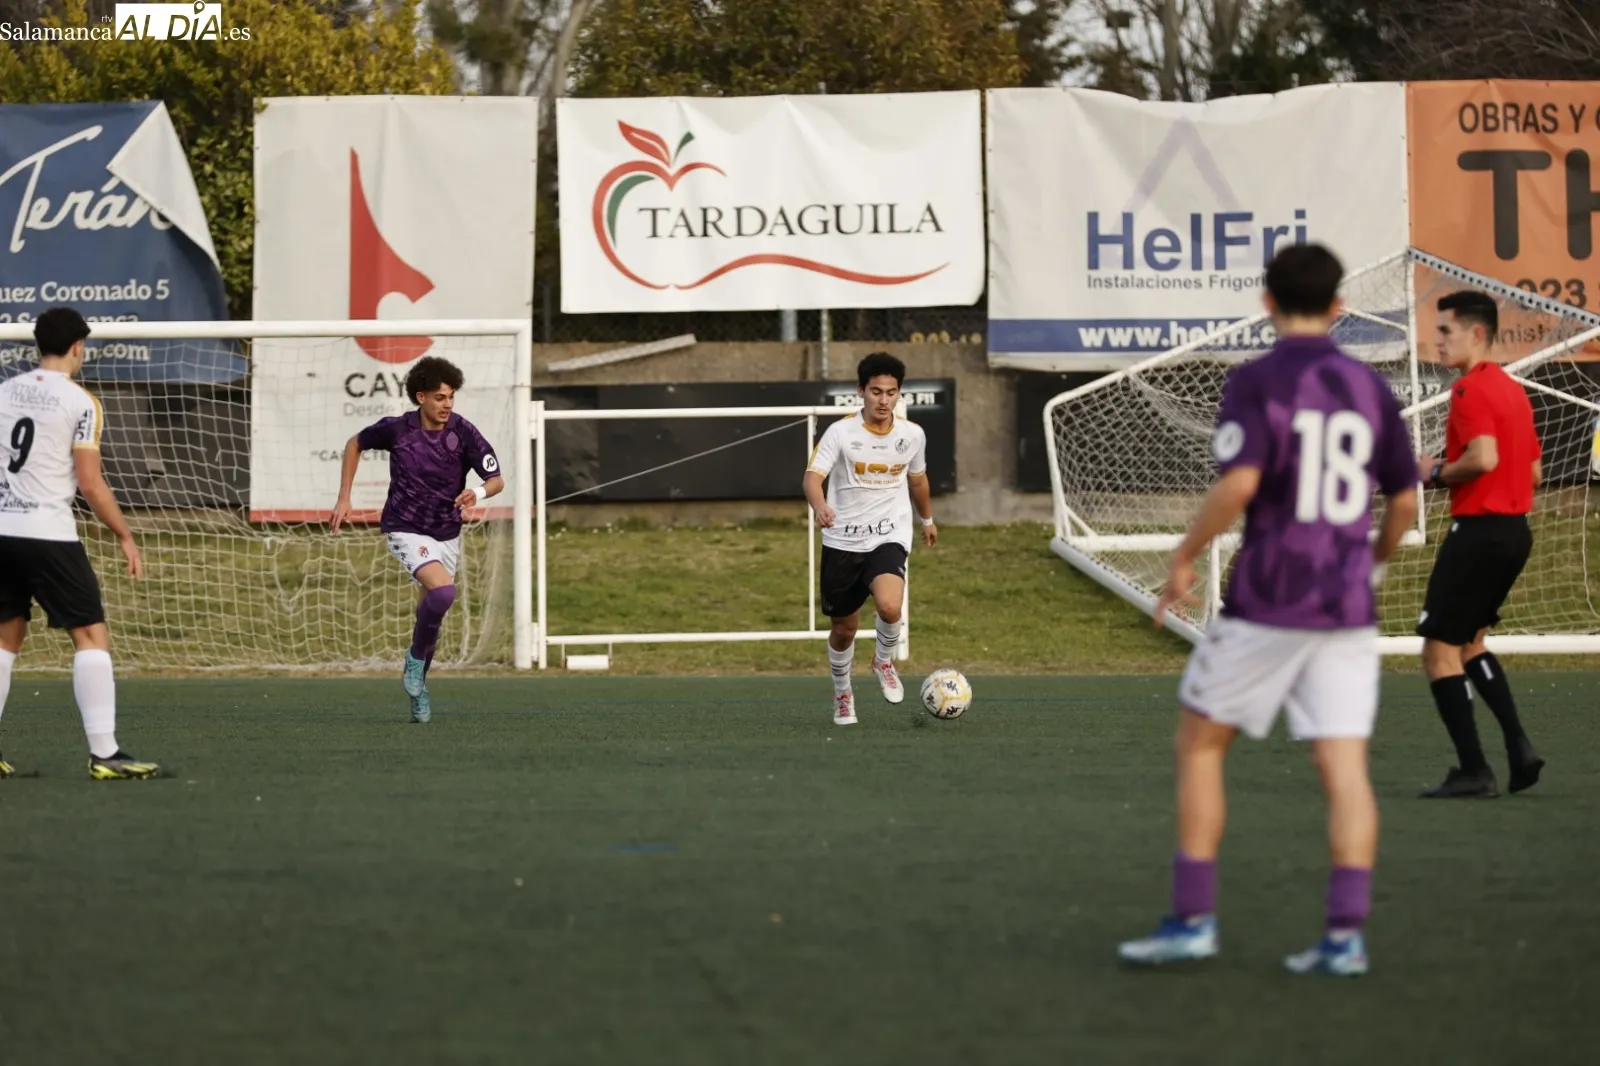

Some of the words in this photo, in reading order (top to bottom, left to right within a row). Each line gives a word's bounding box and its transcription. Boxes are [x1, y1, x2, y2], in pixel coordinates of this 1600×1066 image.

[1458, 102, 1560, 134] OBRAS
[1568, 104, 1587, 133] Y
[638, 202, 945, 239] TARDAGUILA
[1086, 208, 1308, 272] HelFri
[40, 279, 152, 301] Coronado
[156, 279, 170, 300] 5
[1087, 274, 1203, 290] Instalaciones
[8, 417, 35, 474] 9
[1291, 408, 1374, 526] 18
